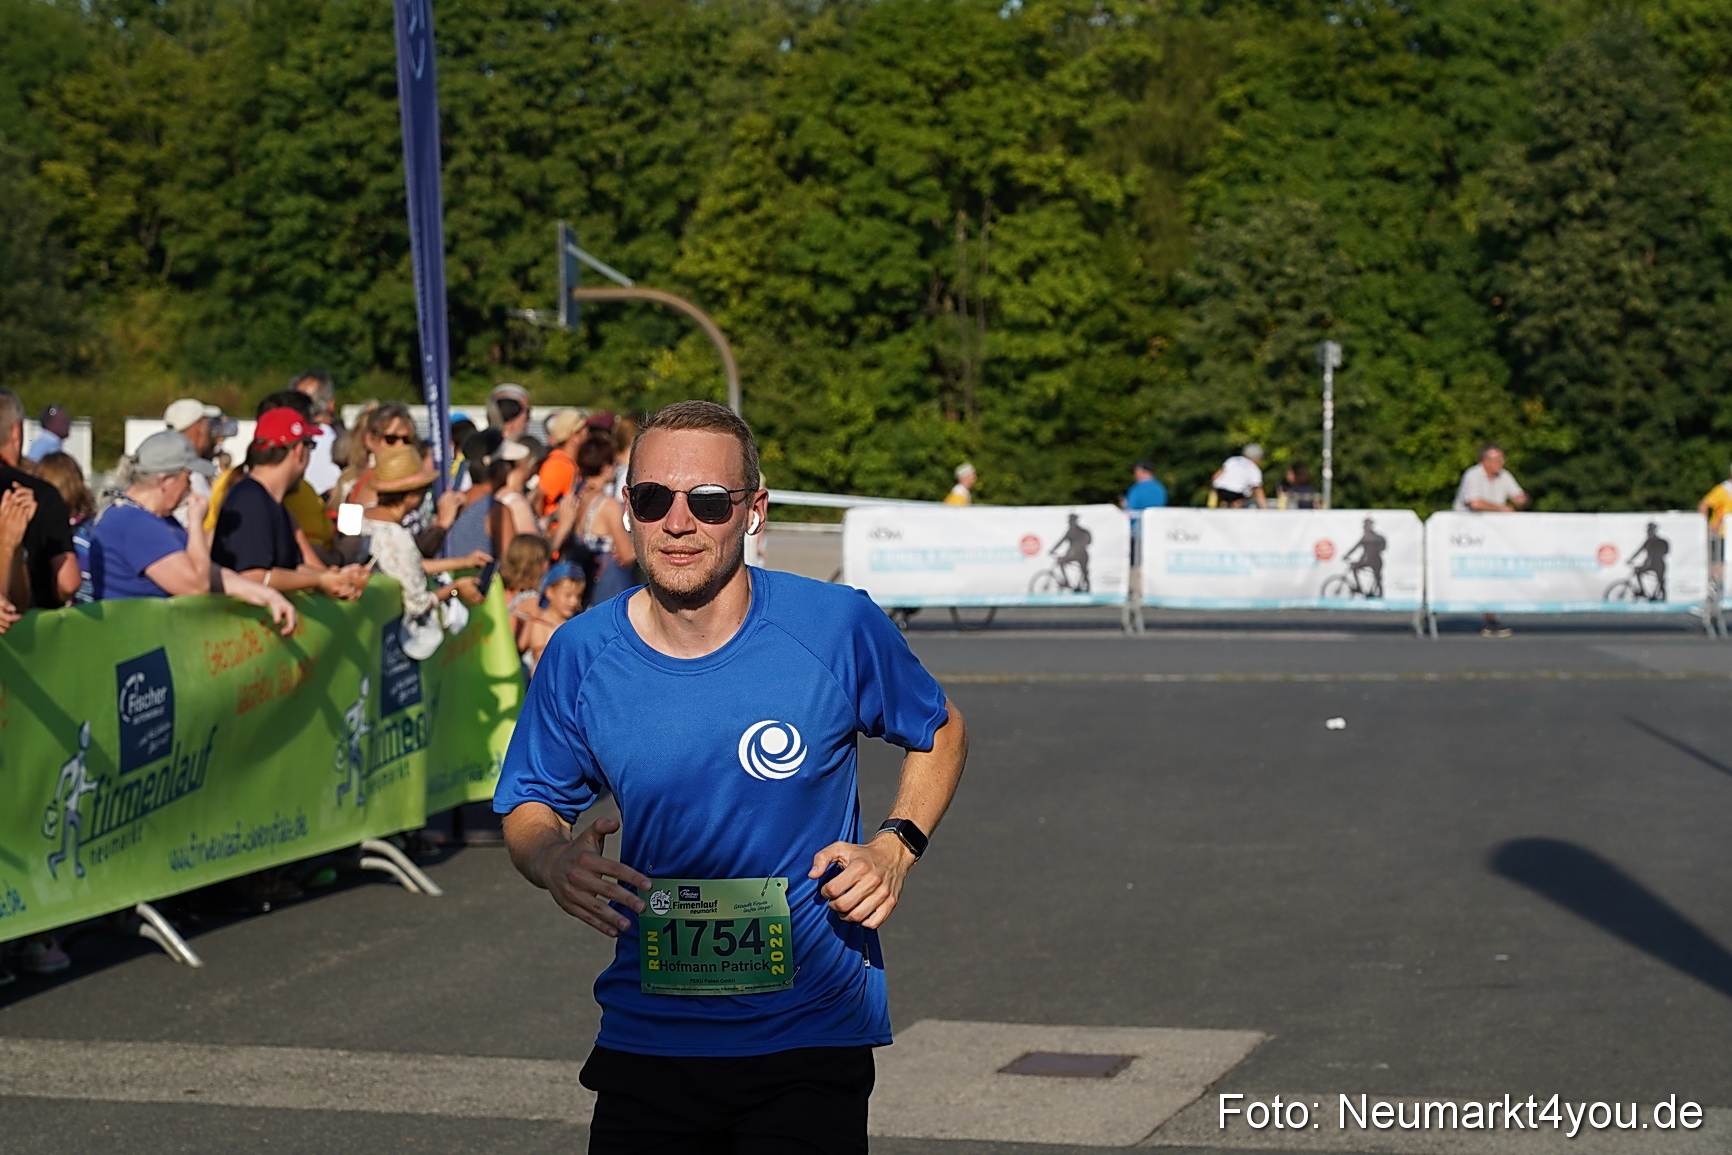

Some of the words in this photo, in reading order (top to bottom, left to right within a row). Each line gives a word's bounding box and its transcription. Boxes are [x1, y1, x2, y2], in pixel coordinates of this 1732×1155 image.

[128, 686, 168, 716] Fischer
[90, 726, 218, 839] firmenlauf
[673, 900, 718, 909] Firmenlauf
[647, 931, 660, 970] RUN
[663, 918, 765, 957] 1754
[769, 923, 785, 976] 2022
[660, 960, 717, 973] Hofmann
[721, 959, 770, 972] Patrick
